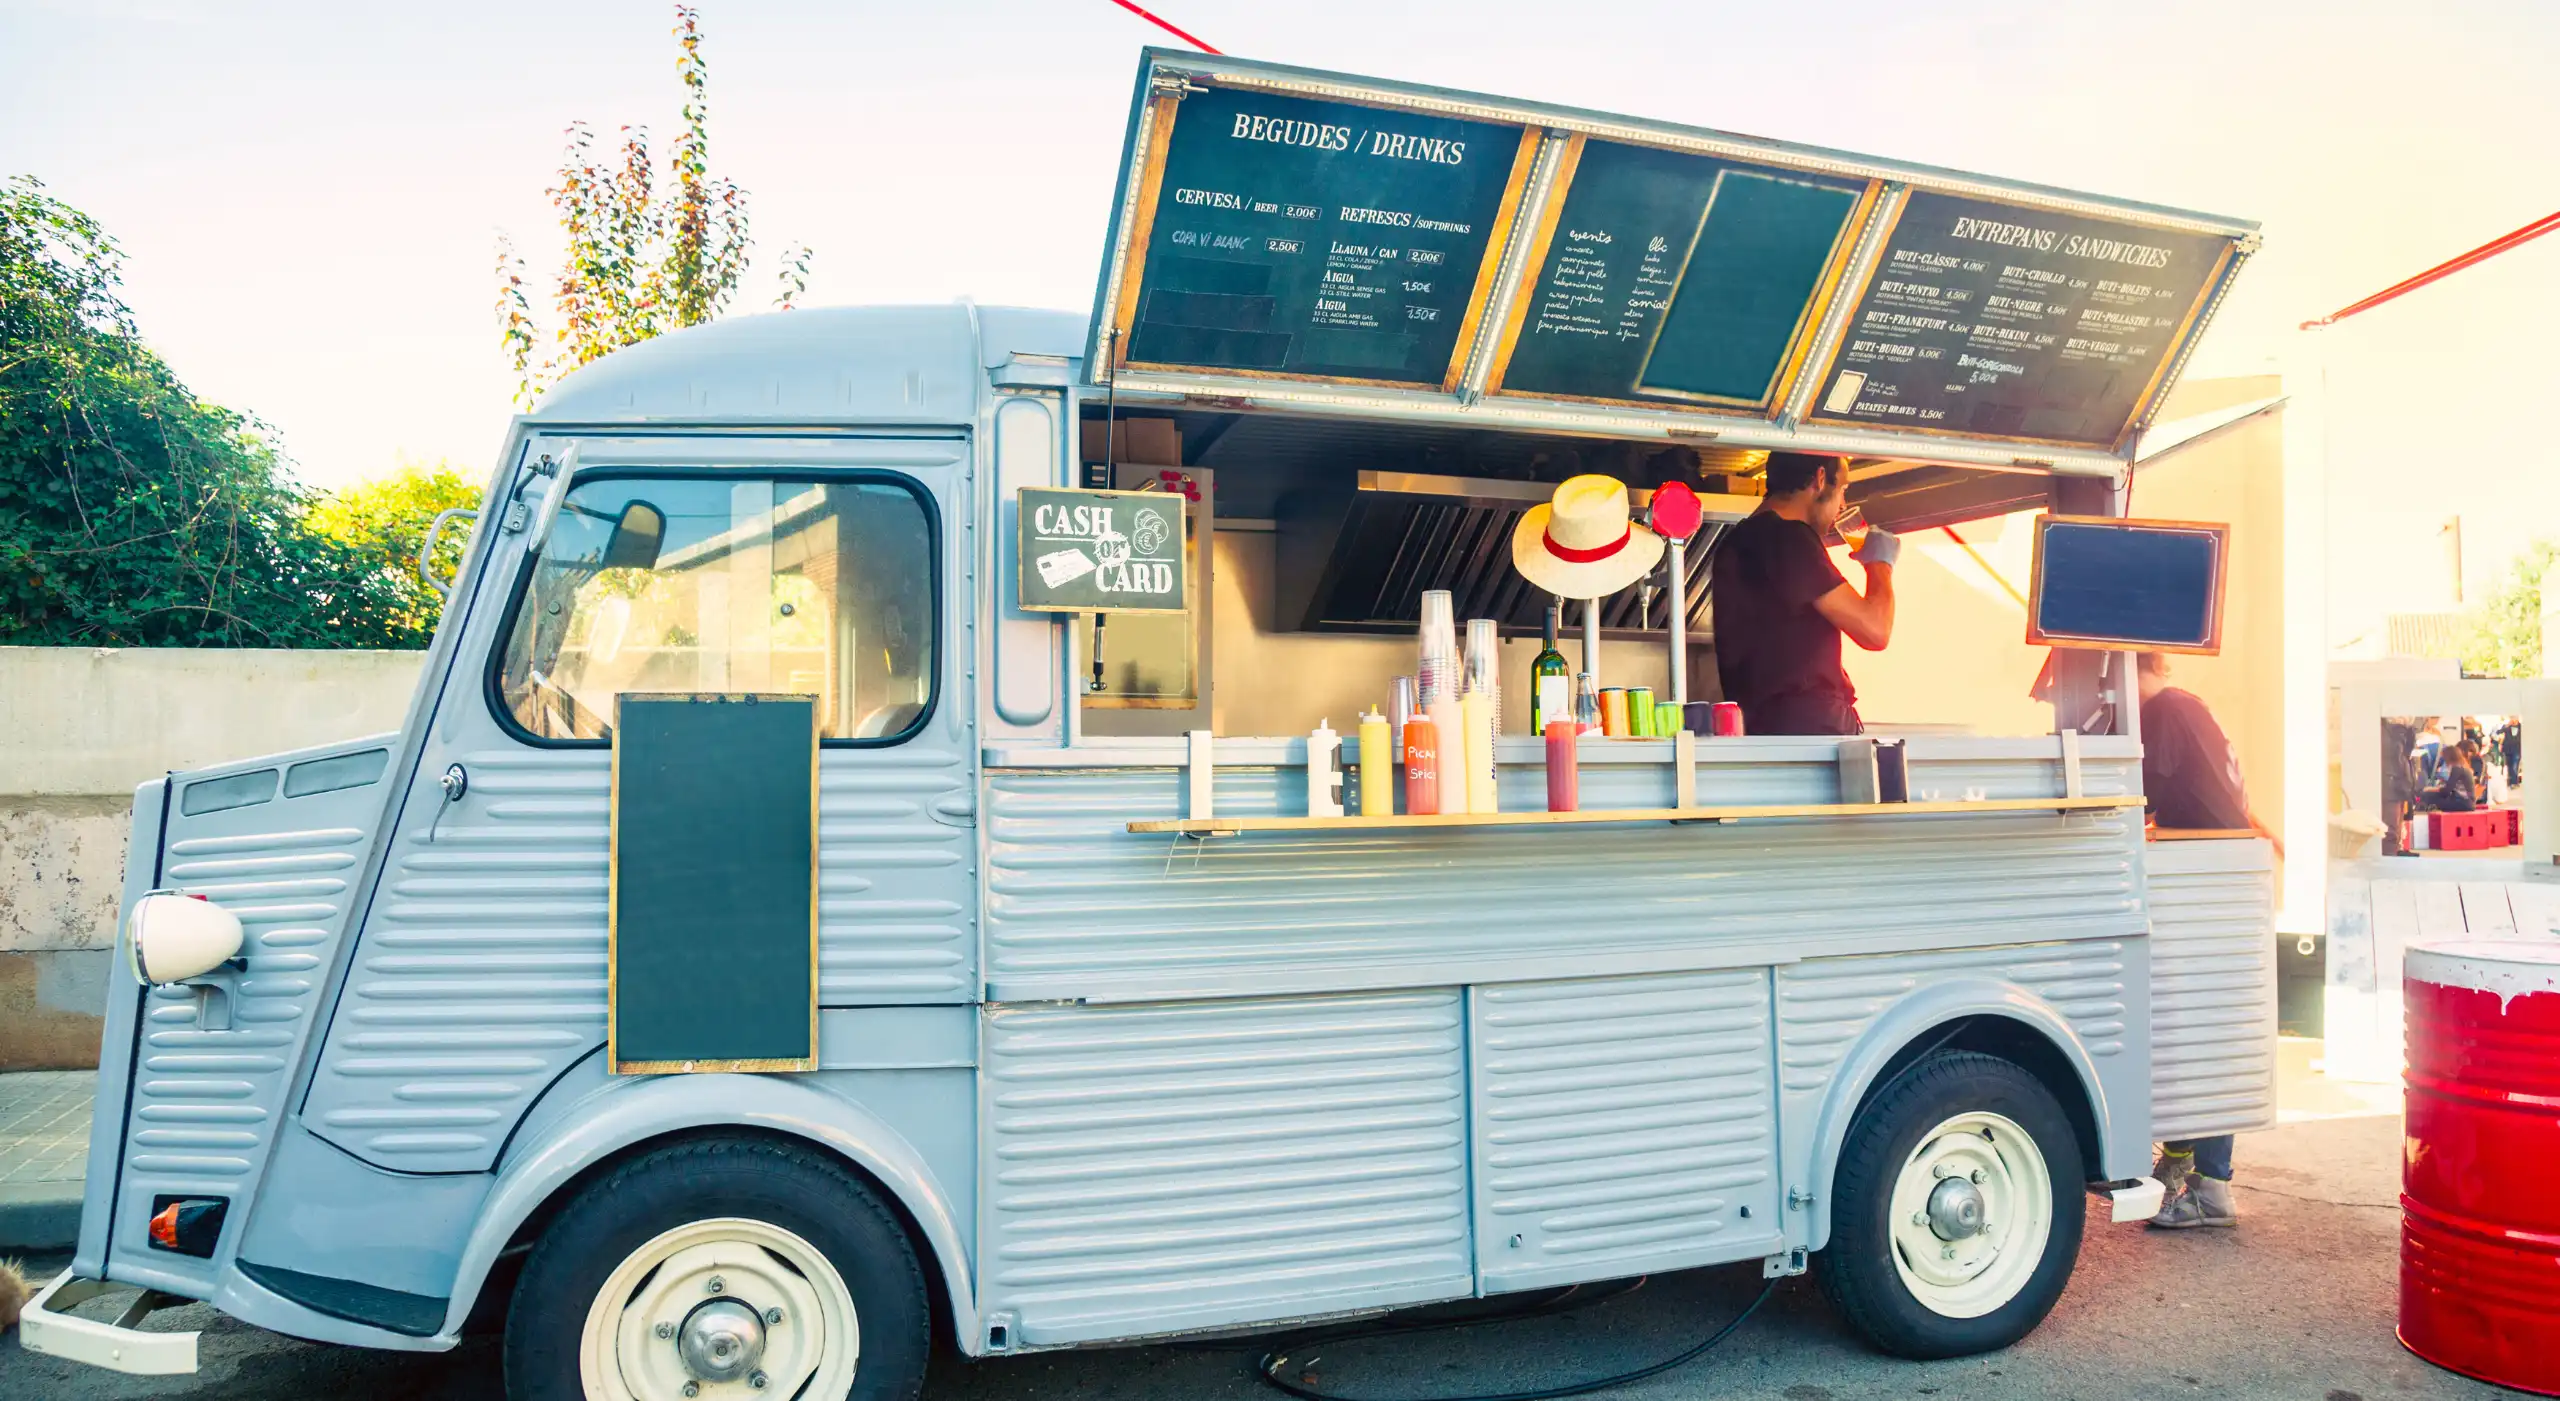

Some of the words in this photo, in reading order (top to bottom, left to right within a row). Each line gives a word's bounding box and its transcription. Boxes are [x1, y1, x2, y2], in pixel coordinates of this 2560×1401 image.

[1231, 113, 1350, 151] BEGUDES
[1354, 129, 1368, 153] /
[1371, 131, 1466, 165] DRINKS
[1175, 188, 1241, 210] CERVESA
[1245, 196, 1253, 211] /
[1254, 202, 1278, 213] BEER
[1340, 206, 1411, 227] REFRESCS
[1172, 230, 1197, 247] COPA
[1213, 235, 1251, 250] BLANC
[1569, 229, 1612, 244] events
[1648, 236, 1668, 253] bbc
[1951, 216, 2055, 251] ENTREPANS
[2053, 233, 2068, 253] /
[2065, 234, 2172, 269] SANDWICHES
[1379, 248, 1399, 259] CAN
[2002, 265, 2066, 285] BUTI-CRIOLLO
[1880, 281, 1940, 298] BUTI-PINTXO
[1569, 293, 1604, 307] populars
[1628, 298, 1670, 310] comiat
[1987, 295, 2044, 313] BUTI-NEGRE
[1328, 318, 1359, 326] SPARKLING
[1866, 311, 1947, 331] BUTI-FRANKFURT
[1554, 322, 1609, 339] gastronomiques
[1973, 325, 2030, 342] BUTI-BIKINI
[1852, 340, 1915, 357] BUTI-BURGER
[2066, 338, 2121, 354] BUTI-VEGGIE
[1855, 401, 1887, 413] PATATES
[1888, 405, 1916, 416] BRAVES
[1034, 504, 1114, 536] CASH
[1095, 563, 1173, 594] CARD
